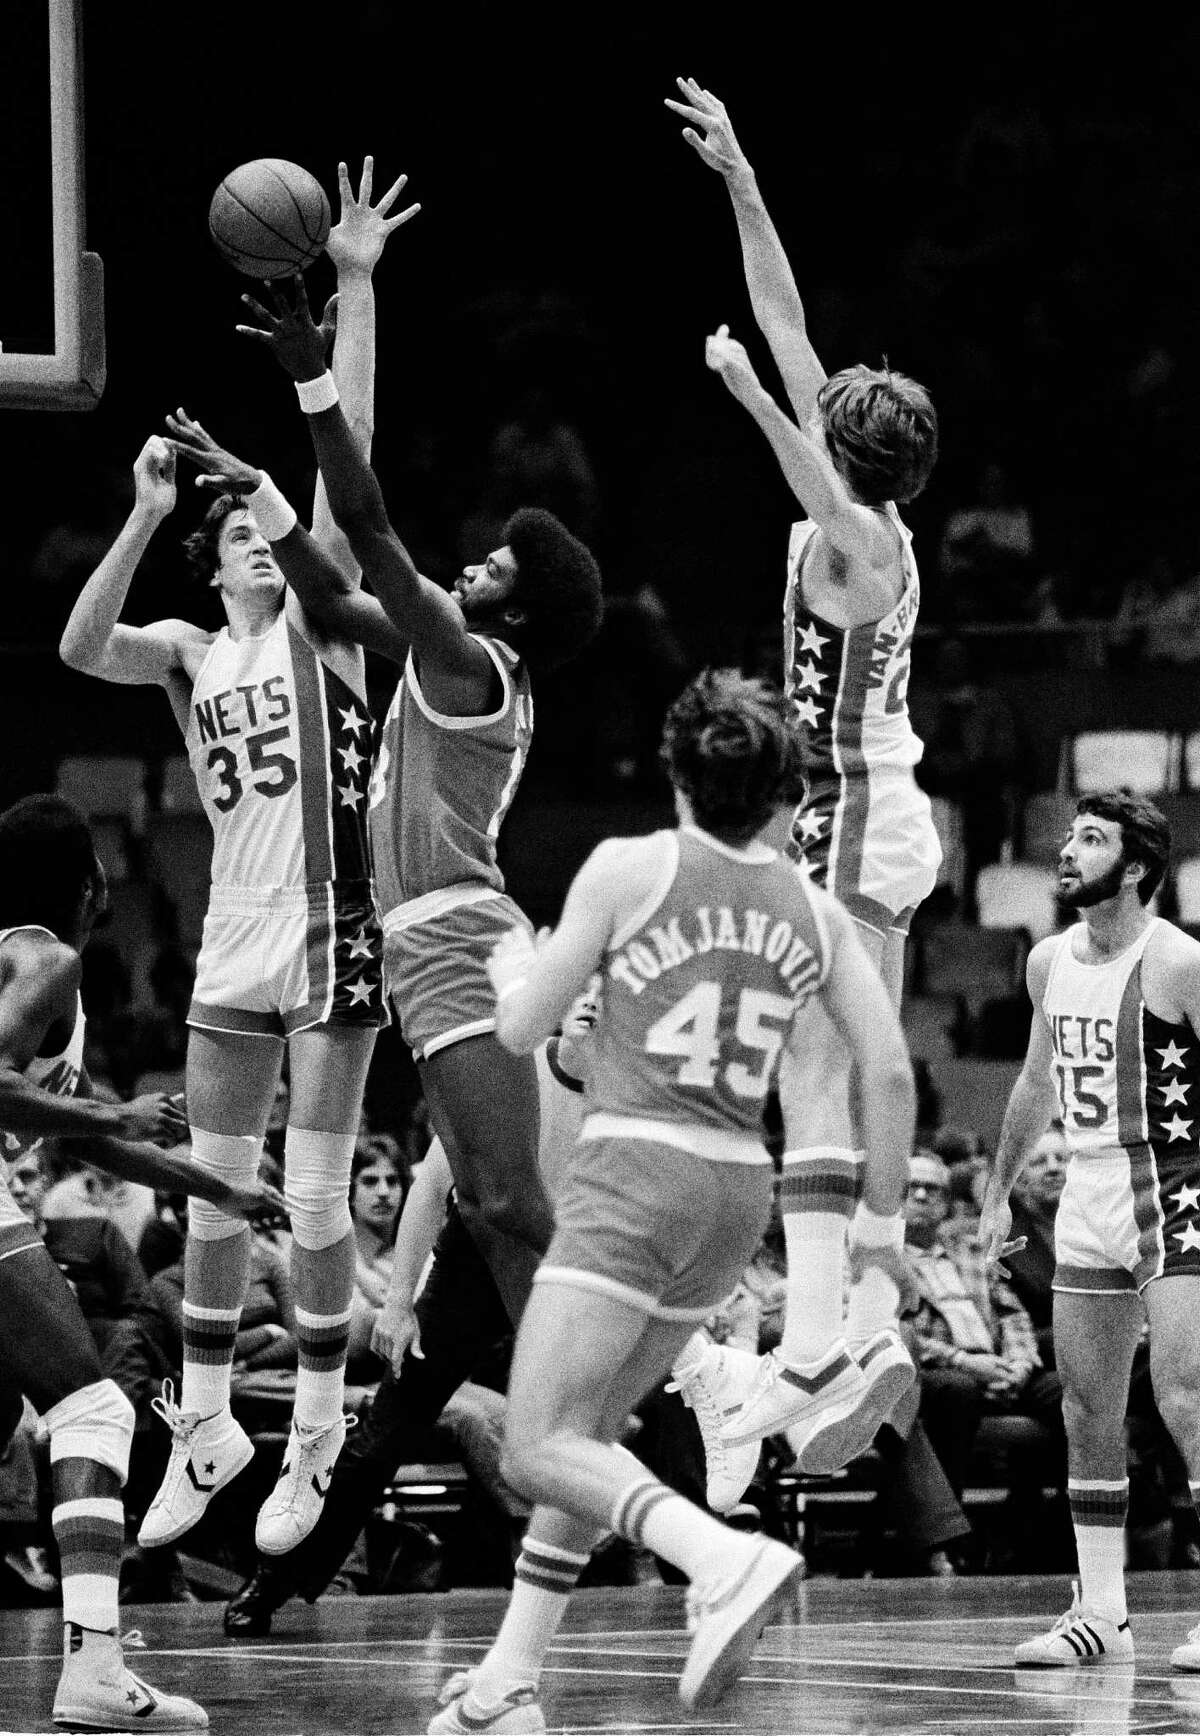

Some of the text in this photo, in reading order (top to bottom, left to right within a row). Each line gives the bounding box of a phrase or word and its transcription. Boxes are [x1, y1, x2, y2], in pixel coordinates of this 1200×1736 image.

[195, 675, 291, 745] NETS
[207, 725, 298, 814] 35
[645, 980, 796, 1098] 45
[1056, 1065, 1109, 1129] 15
